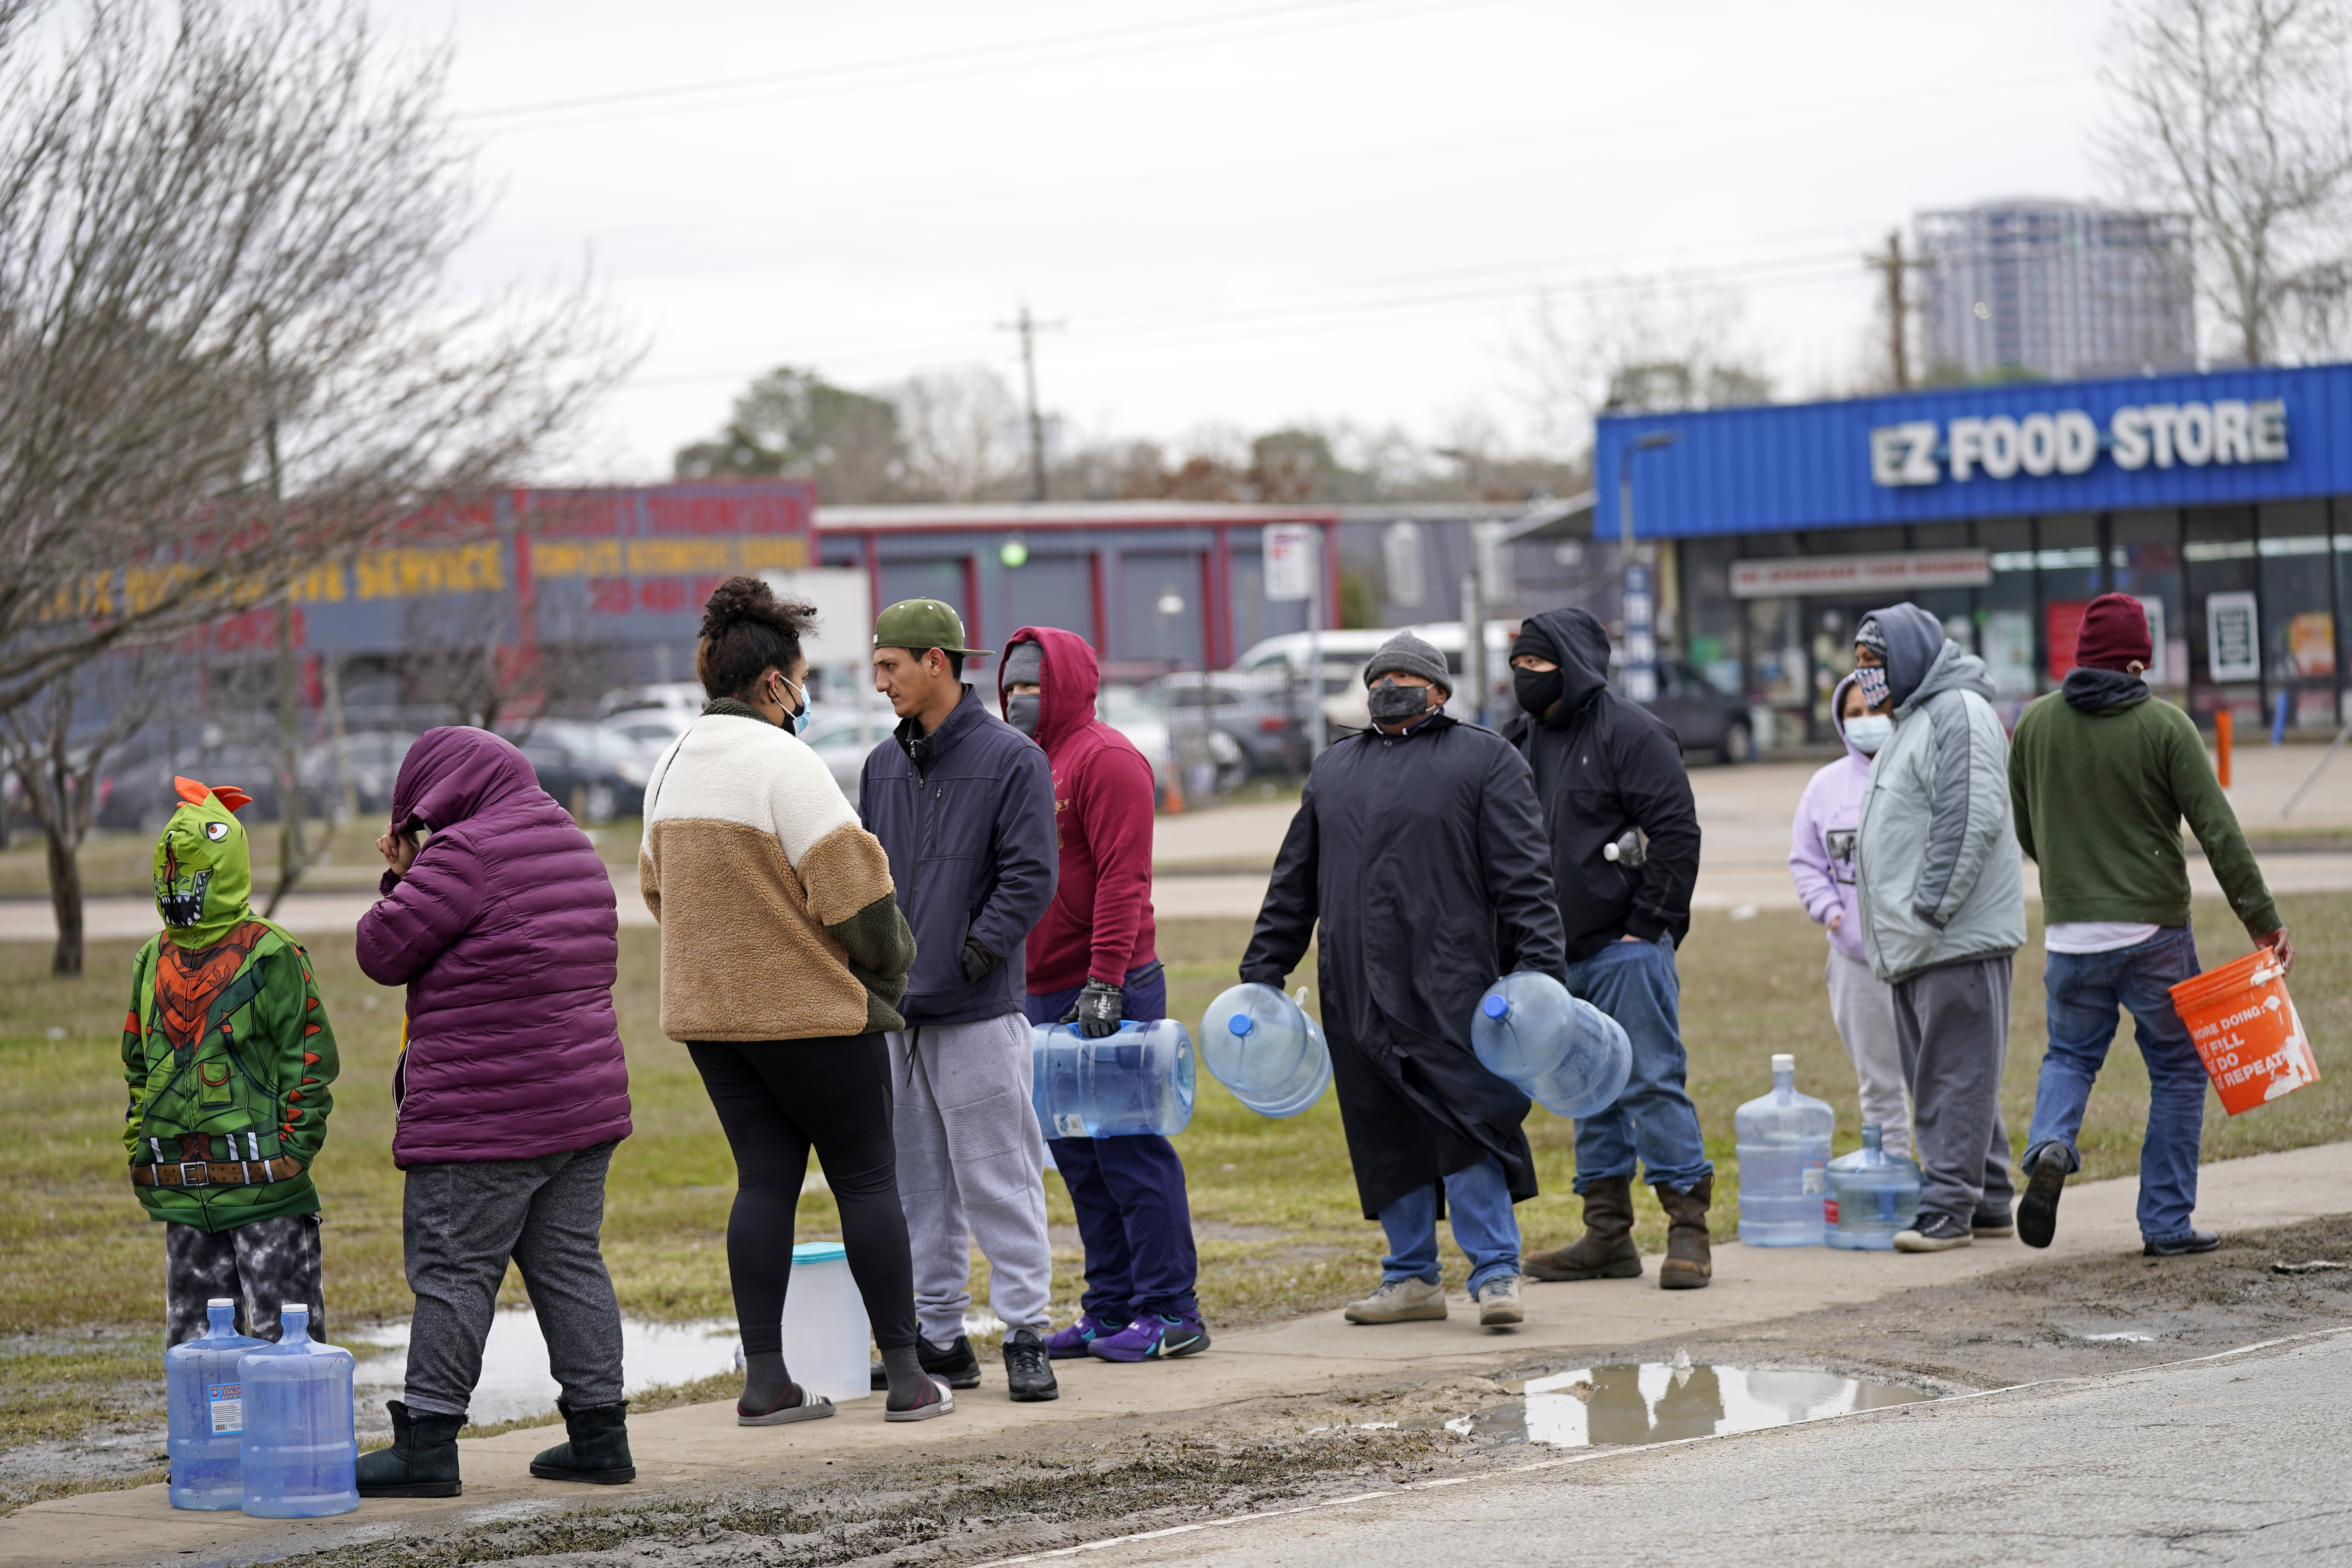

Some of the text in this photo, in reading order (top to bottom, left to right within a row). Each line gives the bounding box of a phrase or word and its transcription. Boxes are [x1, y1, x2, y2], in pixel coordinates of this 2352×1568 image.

[1871, 397, 2288, 486] EZ FOOD STORE
[2220, 1005, 2265, 1031] DOING:
[2209, 1032, 2245, 1055] FILL
[2216, 1052, 2239, 1072] DO
[941, 1402, 953, 1411] adidas
